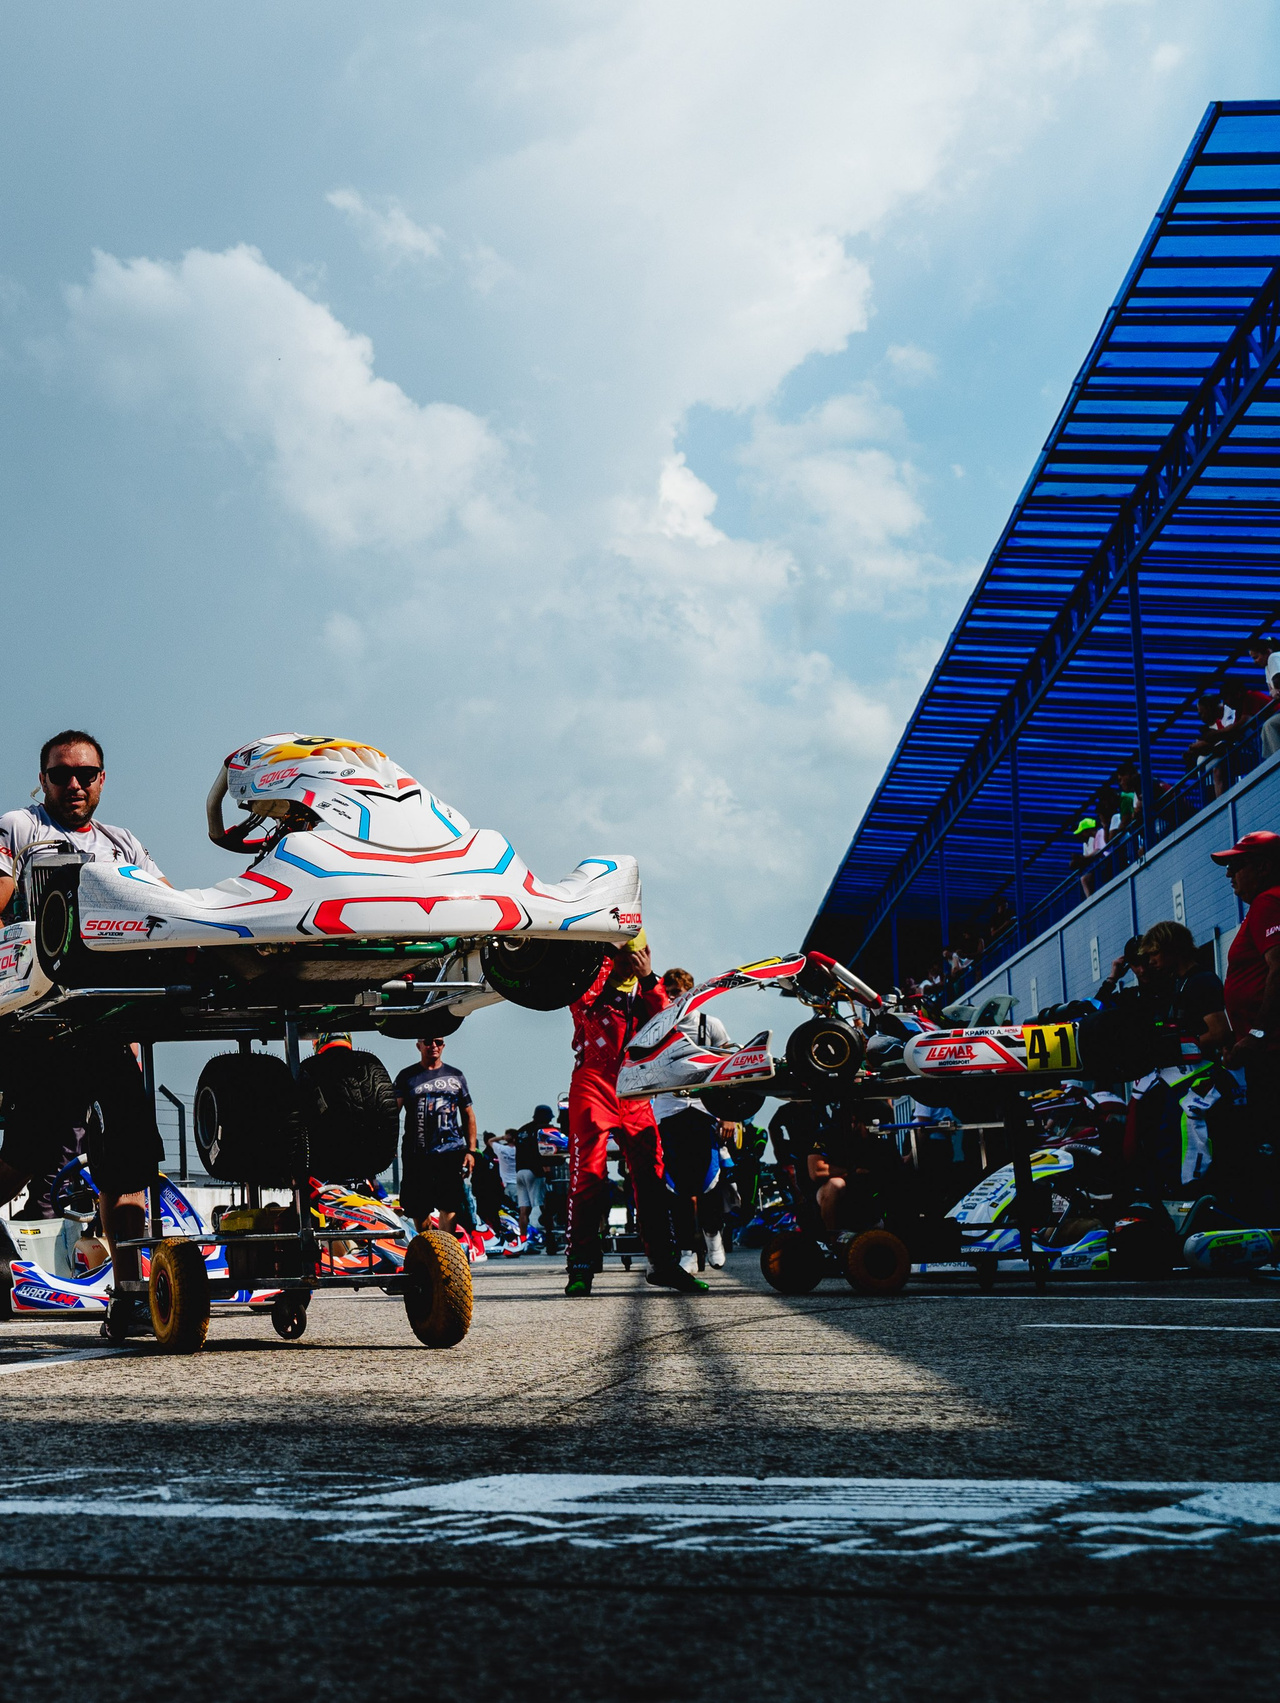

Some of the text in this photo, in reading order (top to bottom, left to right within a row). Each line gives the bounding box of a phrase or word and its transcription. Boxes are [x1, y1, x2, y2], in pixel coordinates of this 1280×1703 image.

[258, 767, 300, 787] SOKOL
[1175, 893, 1183, 921] 5
[84, 920, 149, 932] SOKOL
[964, 1029, 995, 1037] КРАЙКО
[1028, 1026, 1069, 1069] 41
[20, 1286, 80, 1306] KARTLINE
